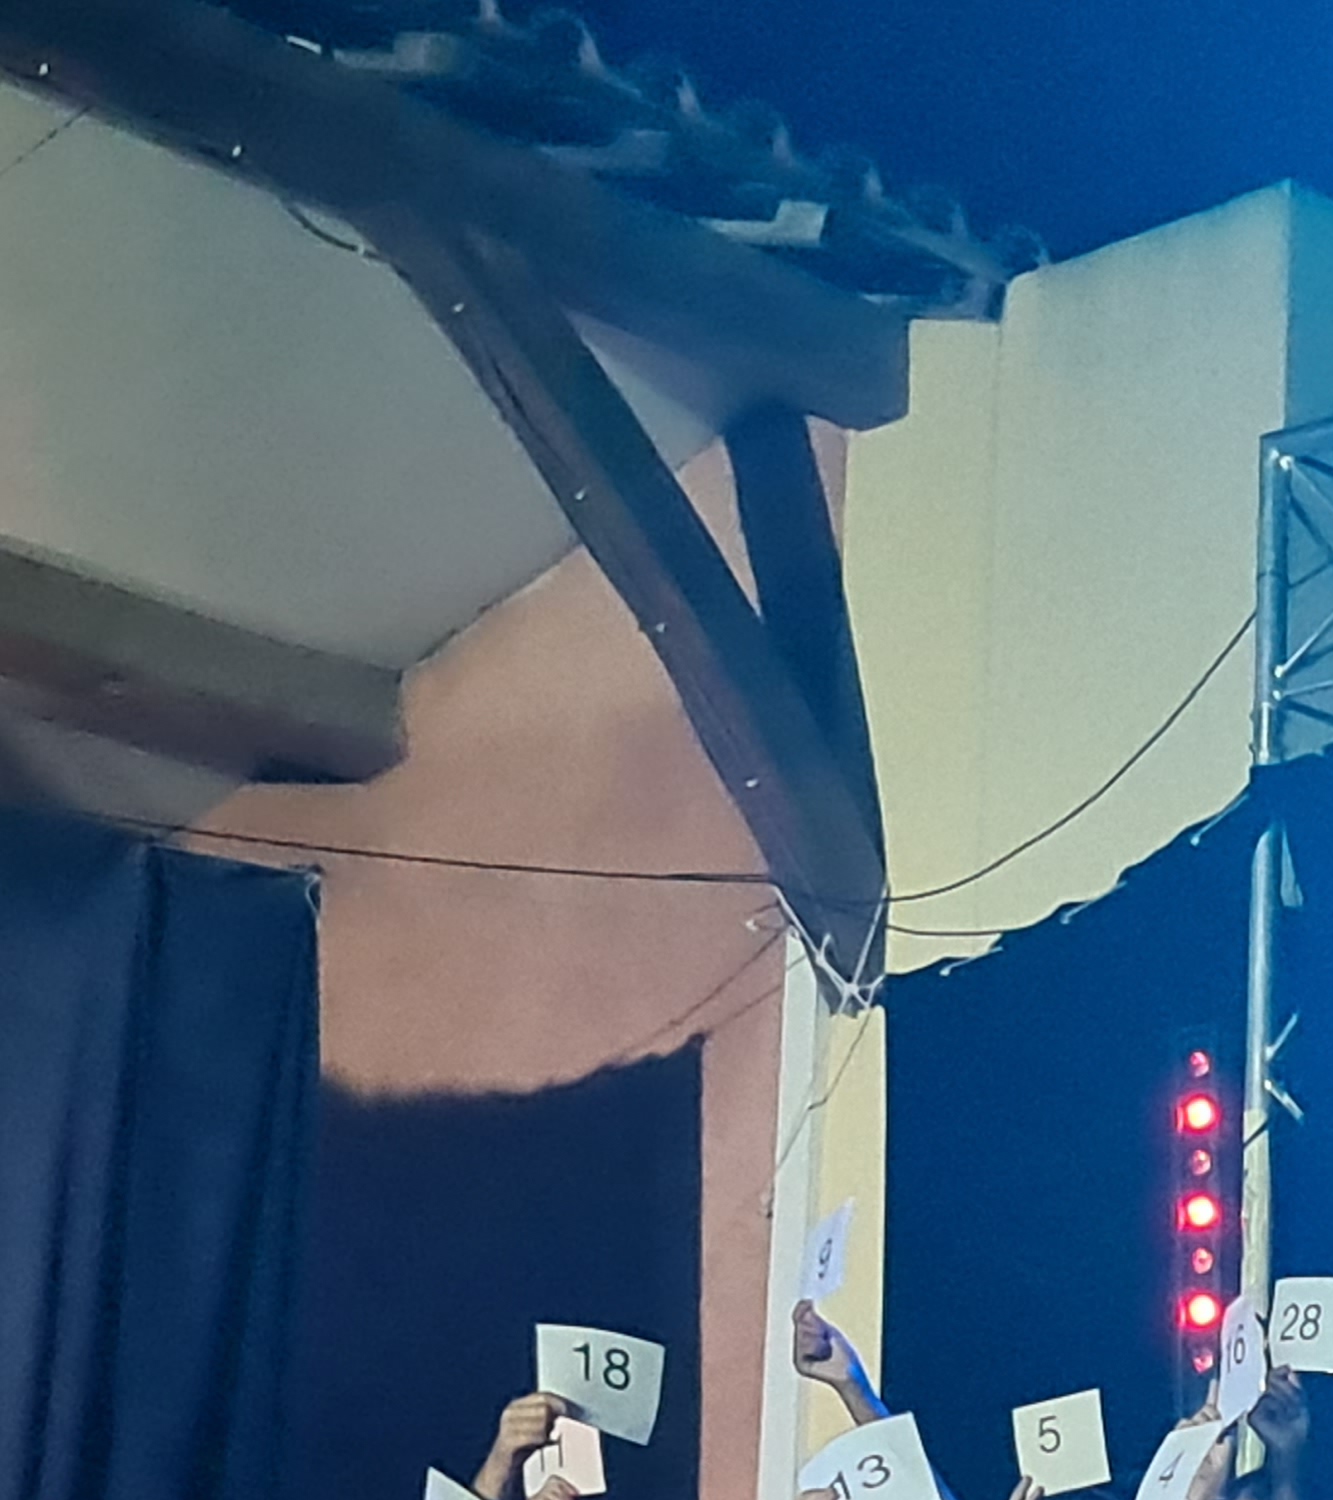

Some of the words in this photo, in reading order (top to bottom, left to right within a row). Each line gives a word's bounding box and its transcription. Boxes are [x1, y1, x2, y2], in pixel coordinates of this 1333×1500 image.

[1280, 1303, 1322, 1341] 28
[572, 1342, 631, 1391] 18
[1038, 1416, 1061, 1454] 5
[833, 1454, 891, 1500] 13
[1159, 1450, 1185, 1488] 4
